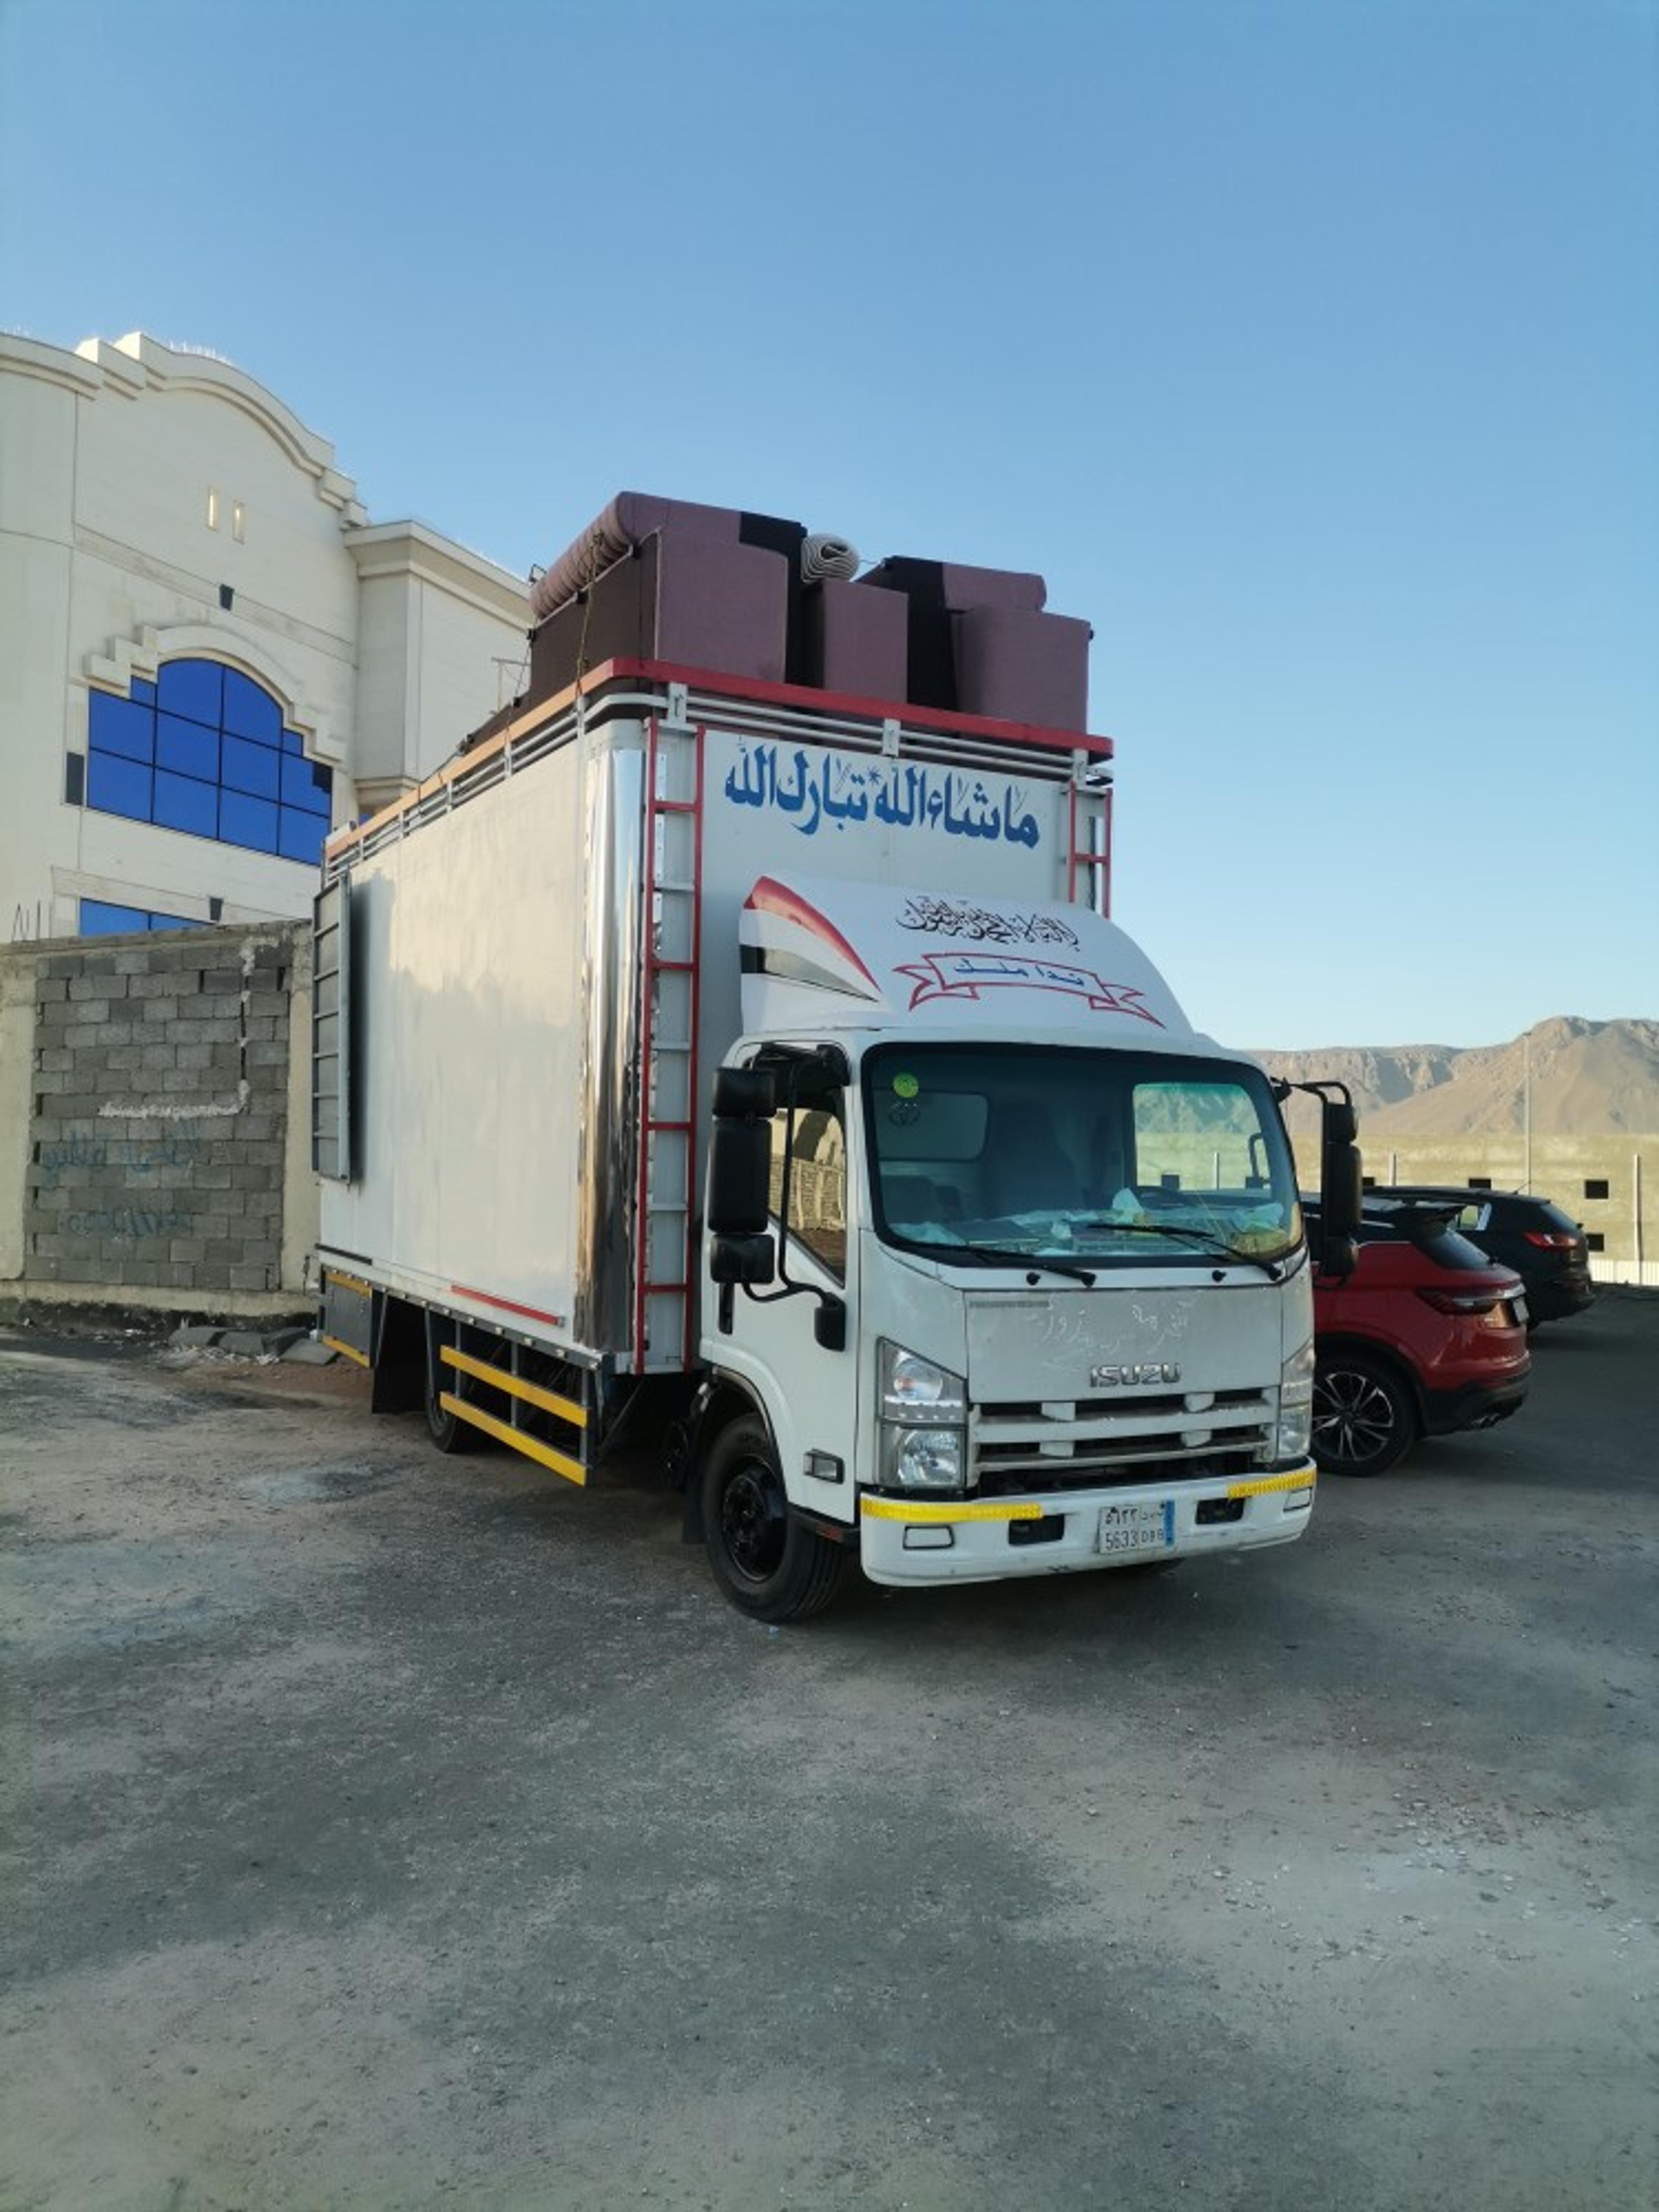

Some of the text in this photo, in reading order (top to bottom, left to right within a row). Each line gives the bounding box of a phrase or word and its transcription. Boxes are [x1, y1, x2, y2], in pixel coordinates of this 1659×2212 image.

[725, 745, 777, 808] الله
[776, 750, 869, 836] تبارك
[874, 766, 926, 827] الله
[1090, 1362, 1180, 1388] ISUZU
[1105, 1530, 1138, 1551] 5633
